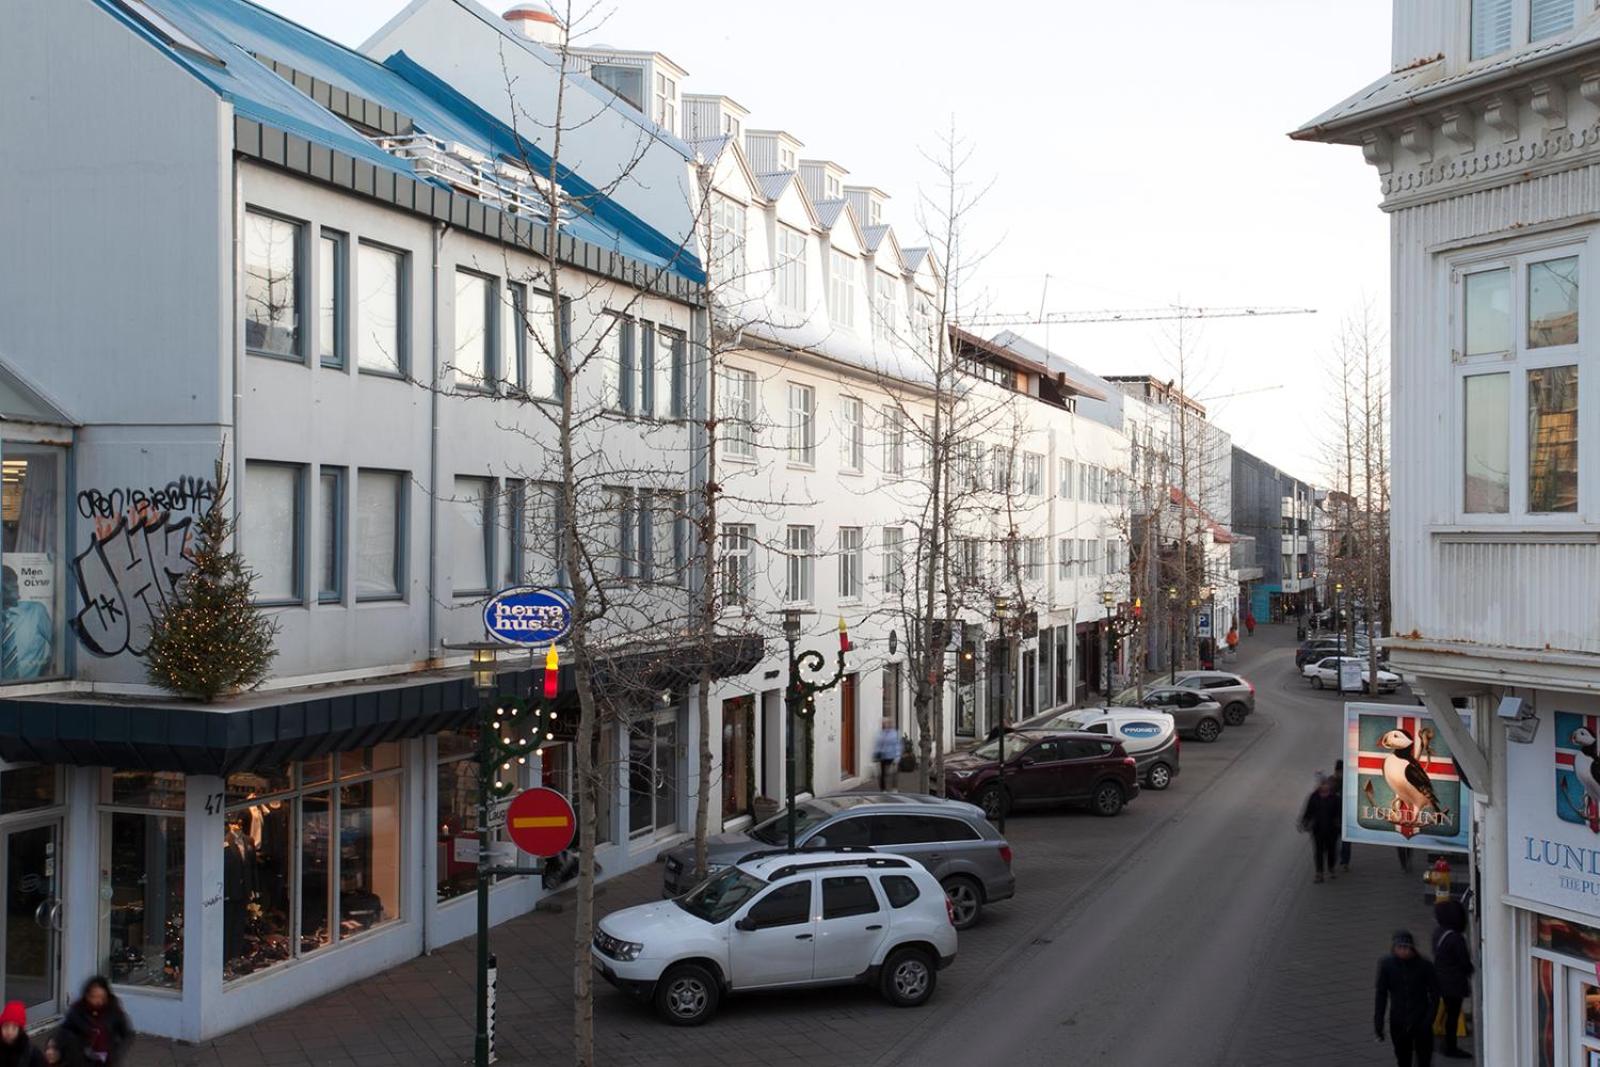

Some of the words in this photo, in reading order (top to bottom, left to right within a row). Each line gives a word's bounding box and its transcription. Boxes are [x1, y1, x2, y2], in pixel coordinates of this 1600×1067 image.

[21, 568, 43, 576] Men
[495, 602, 563, 617] herra
[205, 793, 223, 815] 47
[1361, 806, 1454, 827] LUNDINN
